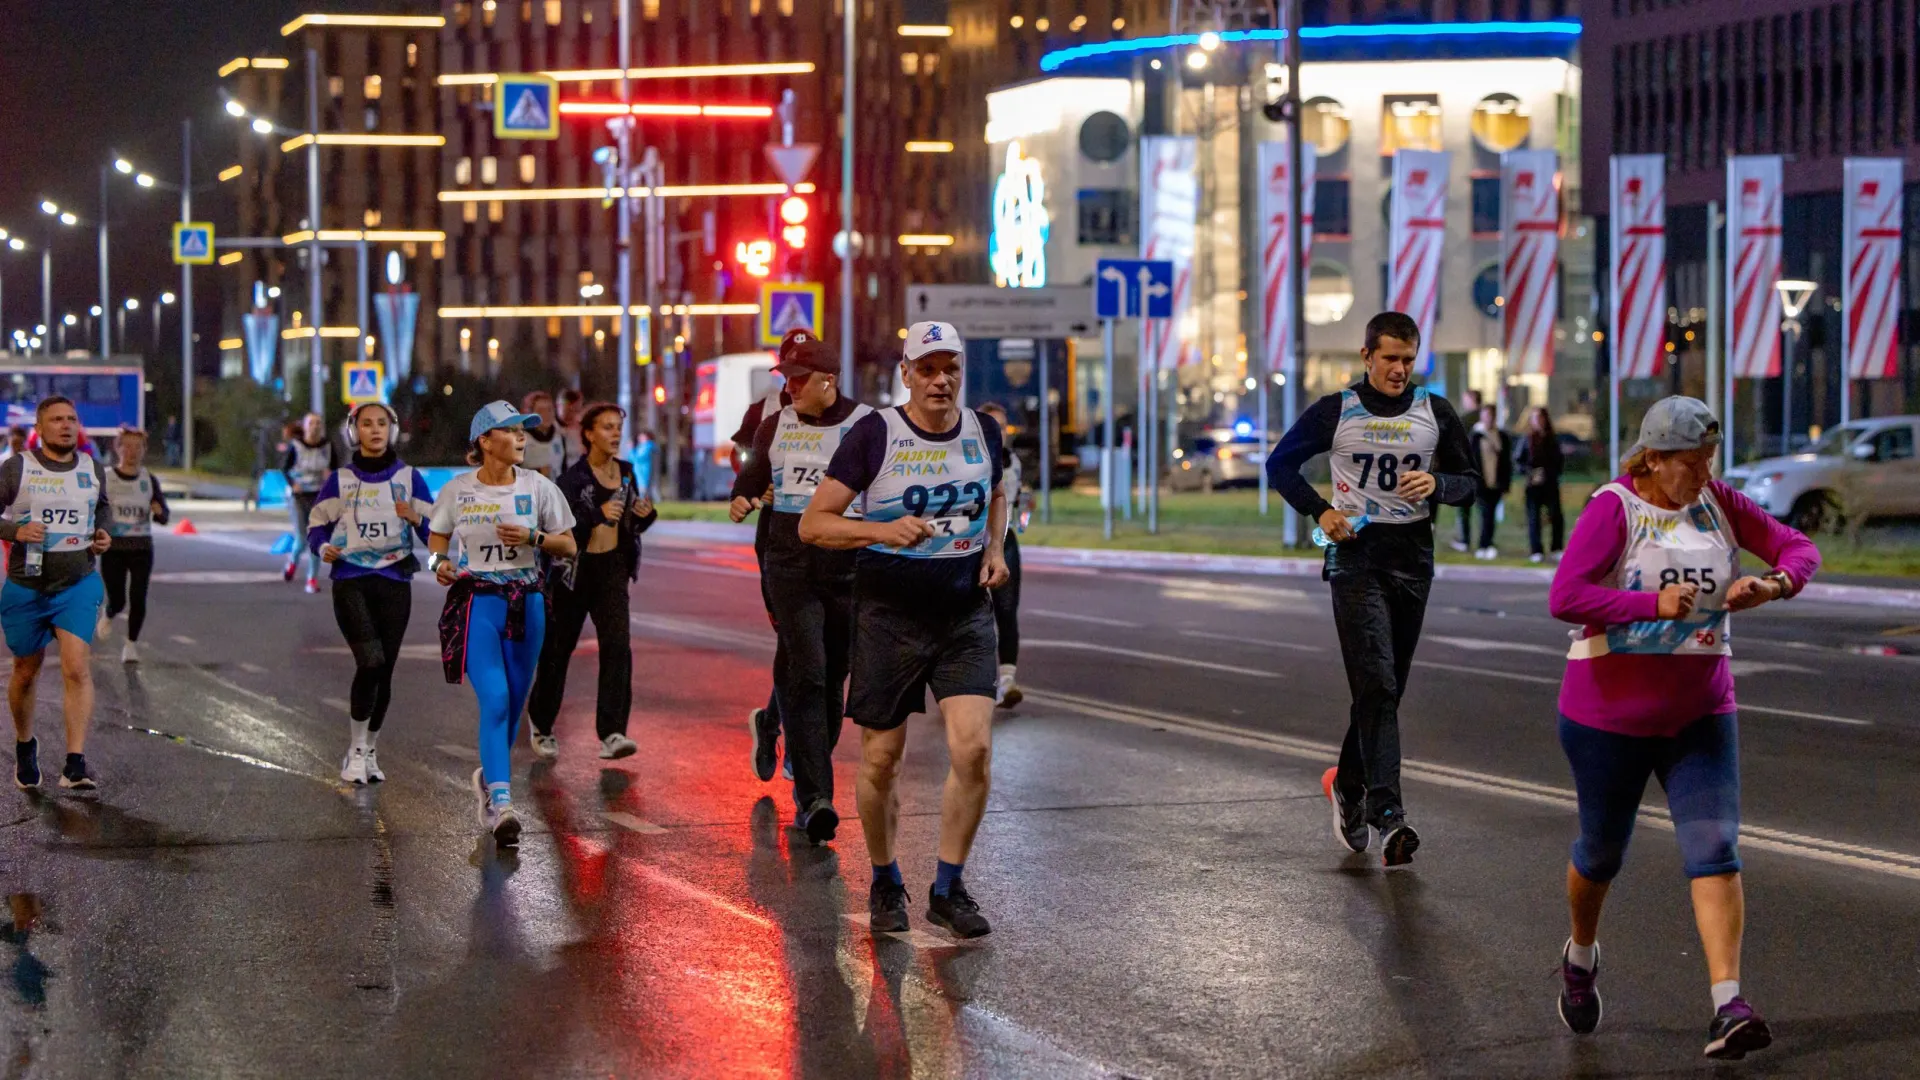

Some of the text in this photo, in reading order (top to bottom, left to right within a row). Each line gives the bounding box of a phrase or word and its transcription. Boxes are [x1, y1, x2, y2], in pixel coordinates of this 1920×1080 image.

[899, 439, 915, 447] ВТБ
[894, 450, 947, 463] РАЗБУДИ
[793, 467, 828, 485] 74
[892, 463, 949, 477] ЯМАЛ
[902, 482, 986, 521] 923
[42, 509, 79, 524] 875
[358, 522, 388, 538] 751
[954, 540, 970, 550] 50
[480, 545, 517, 562] 713
[1659, 568, 1716, 594] 855
